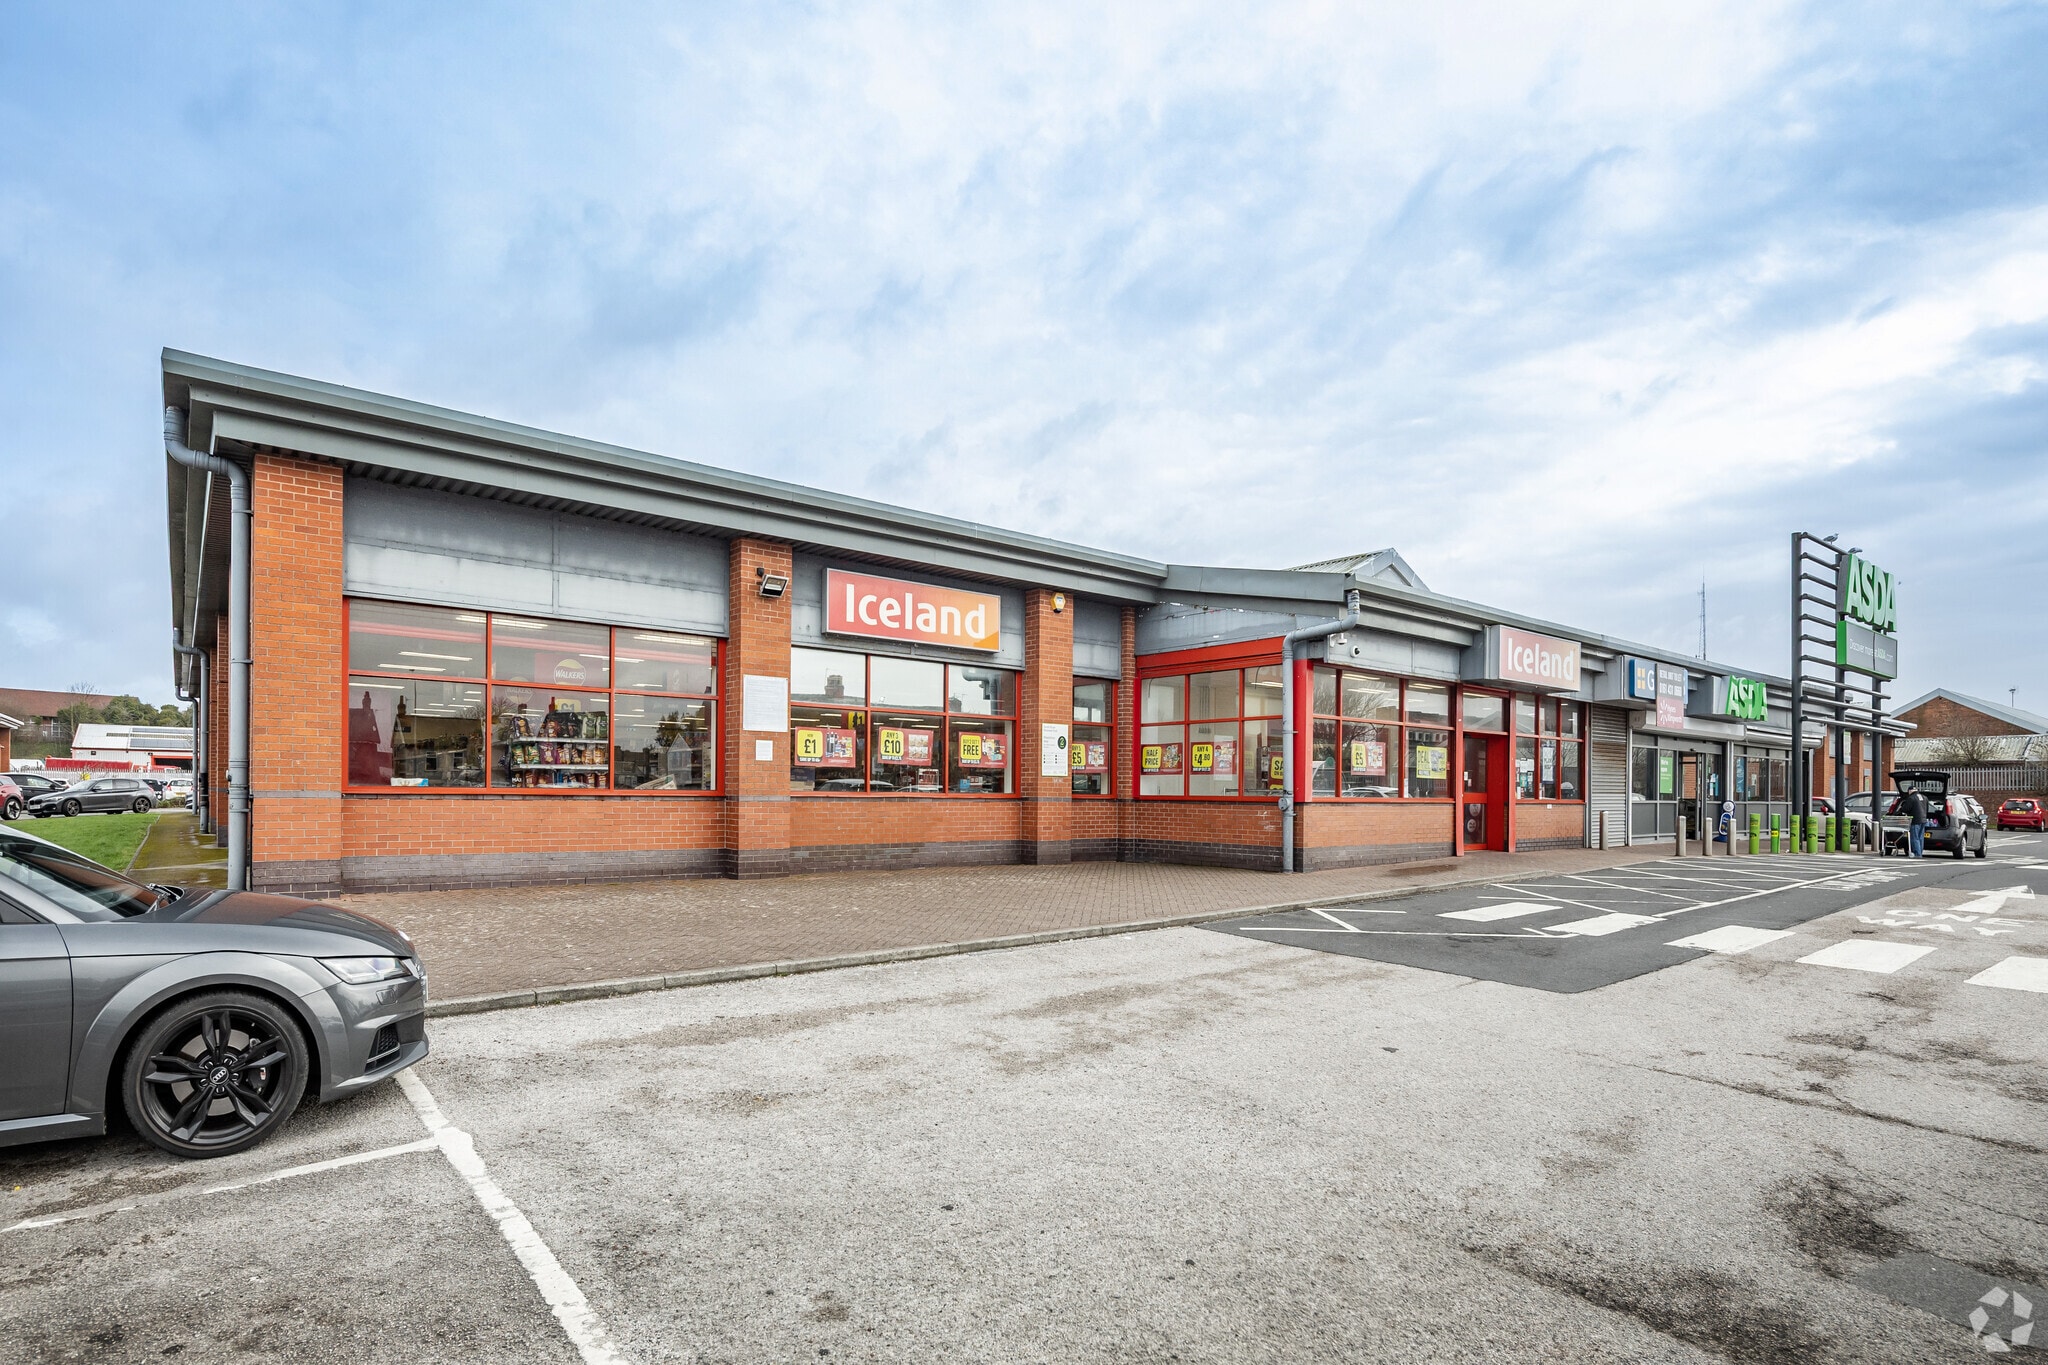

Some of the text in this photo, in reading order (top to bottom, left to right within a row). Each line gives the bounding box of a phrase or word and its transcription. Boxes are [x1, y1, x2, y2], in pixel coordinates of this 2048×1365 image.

[1845, 553, 1897, 632] ASDA
[846, 583, 986, 640] Iceland
[1507, 637, 1574, 681] Iceland
[555, 669, 585, 680] WALKERS
[1726, 674, 1769, 721] ASDA
[886, 731, 896, 739] ANY
[804, 738, 816, 754] £1
[884, 739, 901, 754] £10
[963, 744, 979, 756] FREE
[1146, 749, 1158, 757] HALF
[1072, 751, 1082, 764] £5
[1144, 757, 1159, 766] PRICE
[1355, 752, 1364, 765] £5
[1417, 750, 1430, 764] DEAL
[1856, 916, 2015, 936] WAY
[1886, 910, 2034, 928] ONE
